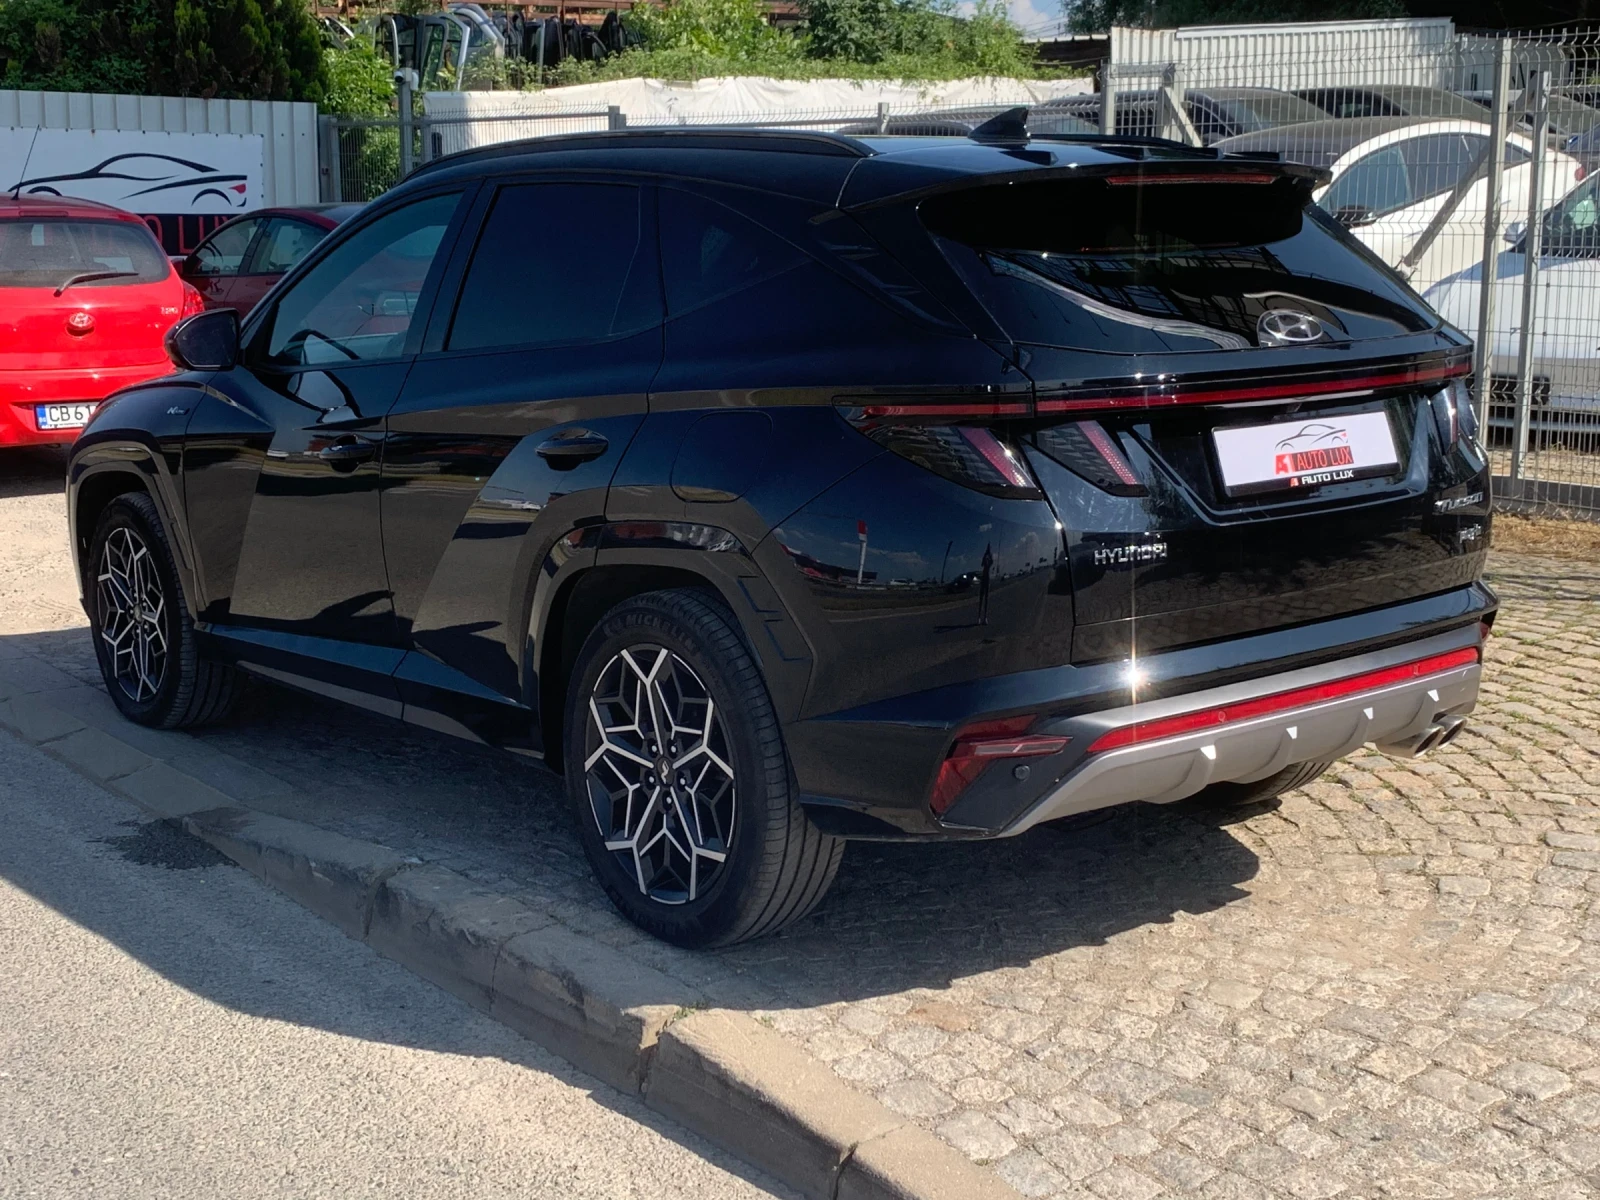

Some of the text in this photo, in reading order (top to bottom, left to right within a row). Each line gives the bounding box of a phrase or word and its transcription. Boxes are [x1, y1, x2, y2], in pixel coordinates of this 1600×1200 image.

[1297, 450, 1328, 471] AUTO
[1329, 447, 1353, 466] LUX
[1301, 473, 1331, 485] AUTO
[1333, 469, 1354, 480] LUX
